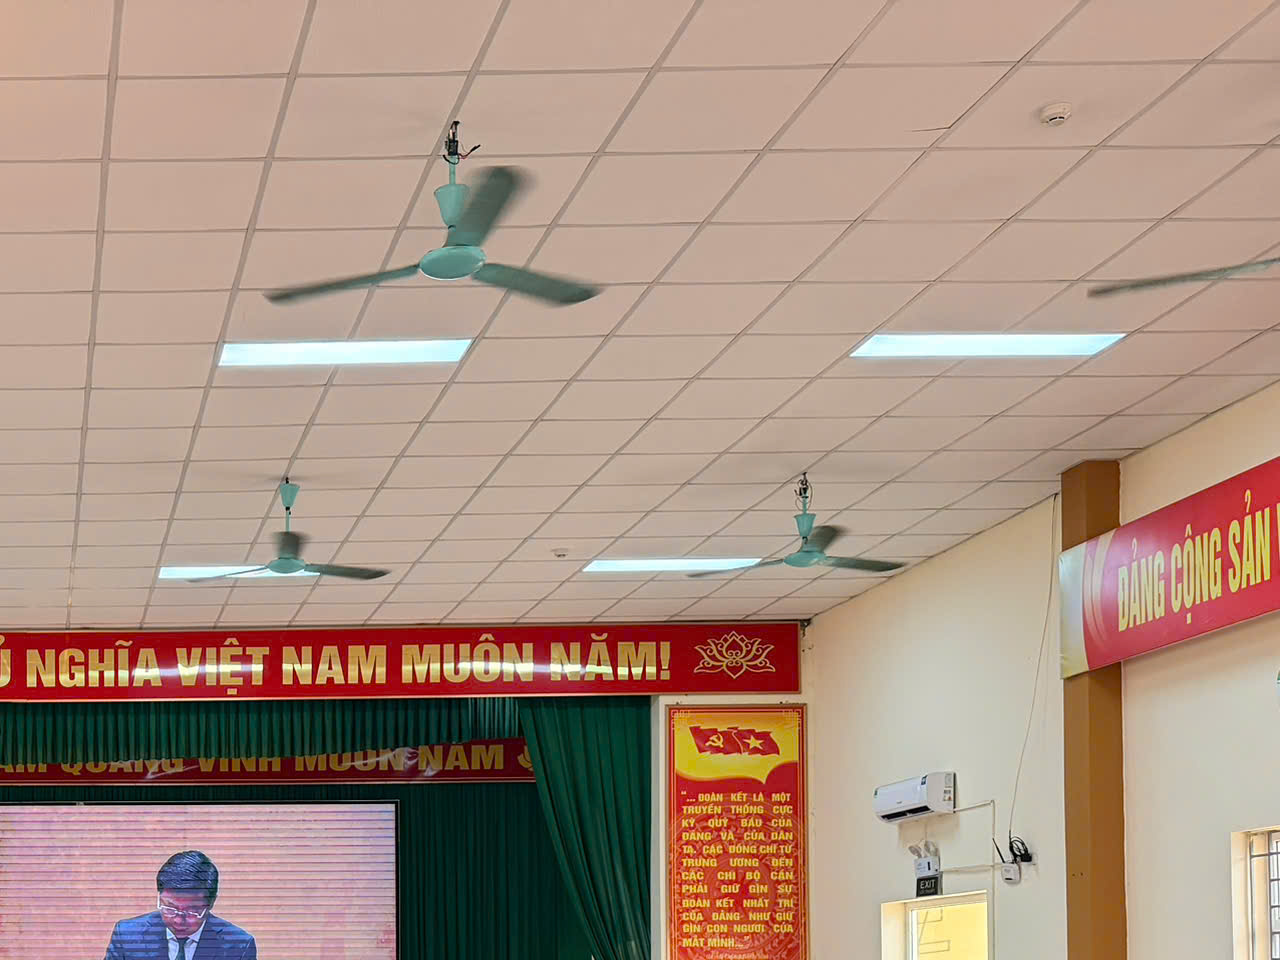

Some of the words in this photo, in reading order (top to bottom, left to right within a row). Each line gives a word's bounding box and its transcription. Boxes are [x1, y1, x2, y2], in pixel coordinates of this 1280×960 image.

[1118, 537, 1165, 632] ĐẢNG
[1171, 523, 1222, 624] CỘNG
[1228, 489, 1271, 593] SẢN
[26, 640, 162, 688] NGHĨA
[176, 637, 269, 695] VIỆT
[282, 644, 387, 685] NAM
[402, 633, 534, 684] MUÔN
[550, 632, 671, 682] NĂM!
[920, 880, 936, 889] EXIT
